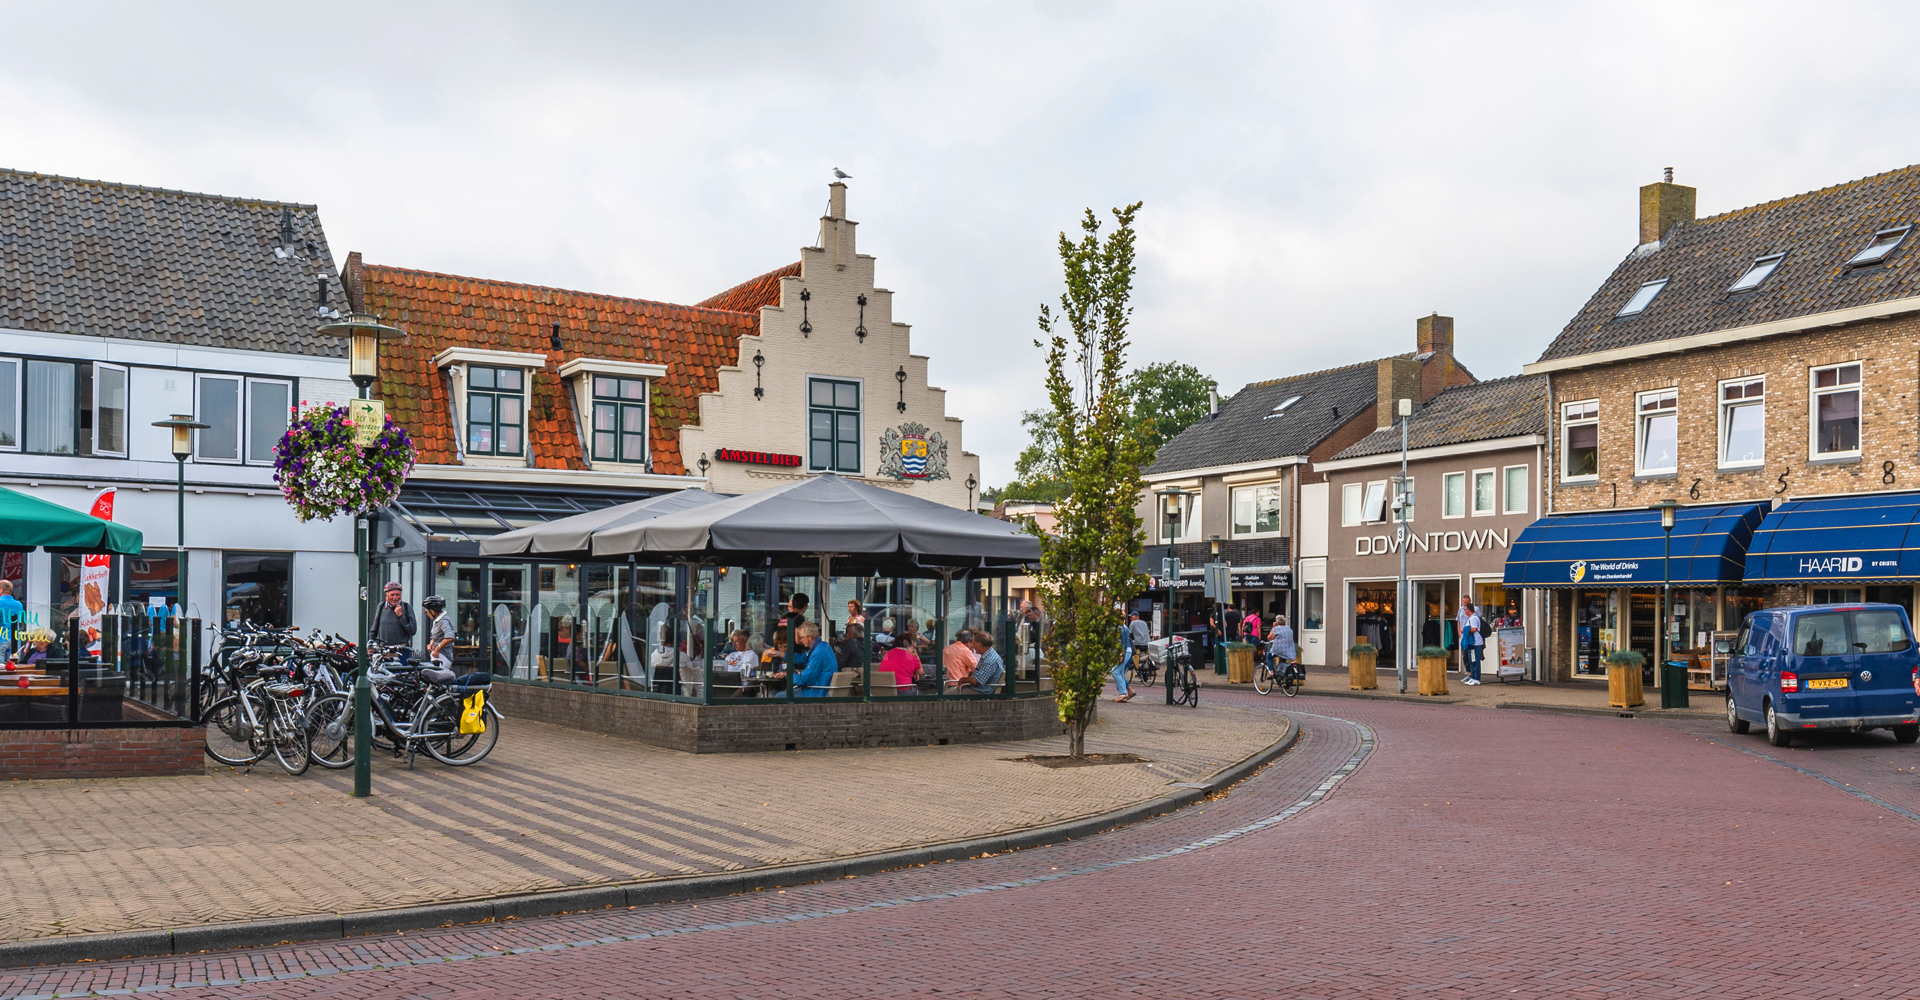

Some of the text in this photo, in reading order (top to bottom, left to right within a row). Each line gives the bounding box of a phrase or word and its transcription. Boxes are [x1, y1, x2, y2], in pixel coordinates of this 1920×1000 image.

[720, 448, 800, 466] AMSTEL BIER
[1690, 478, 1700, 500] 6
[1775, 466, 1790, 494] 5
[1882, 460, 1895, 484] 8
[1356, 528, 1508, 556] DOWNTOWN
[1398, 530, 1402, 538] 3
[4, 566, 22, 578] Vi
[1800, 557, 1862, 573] HAARID
